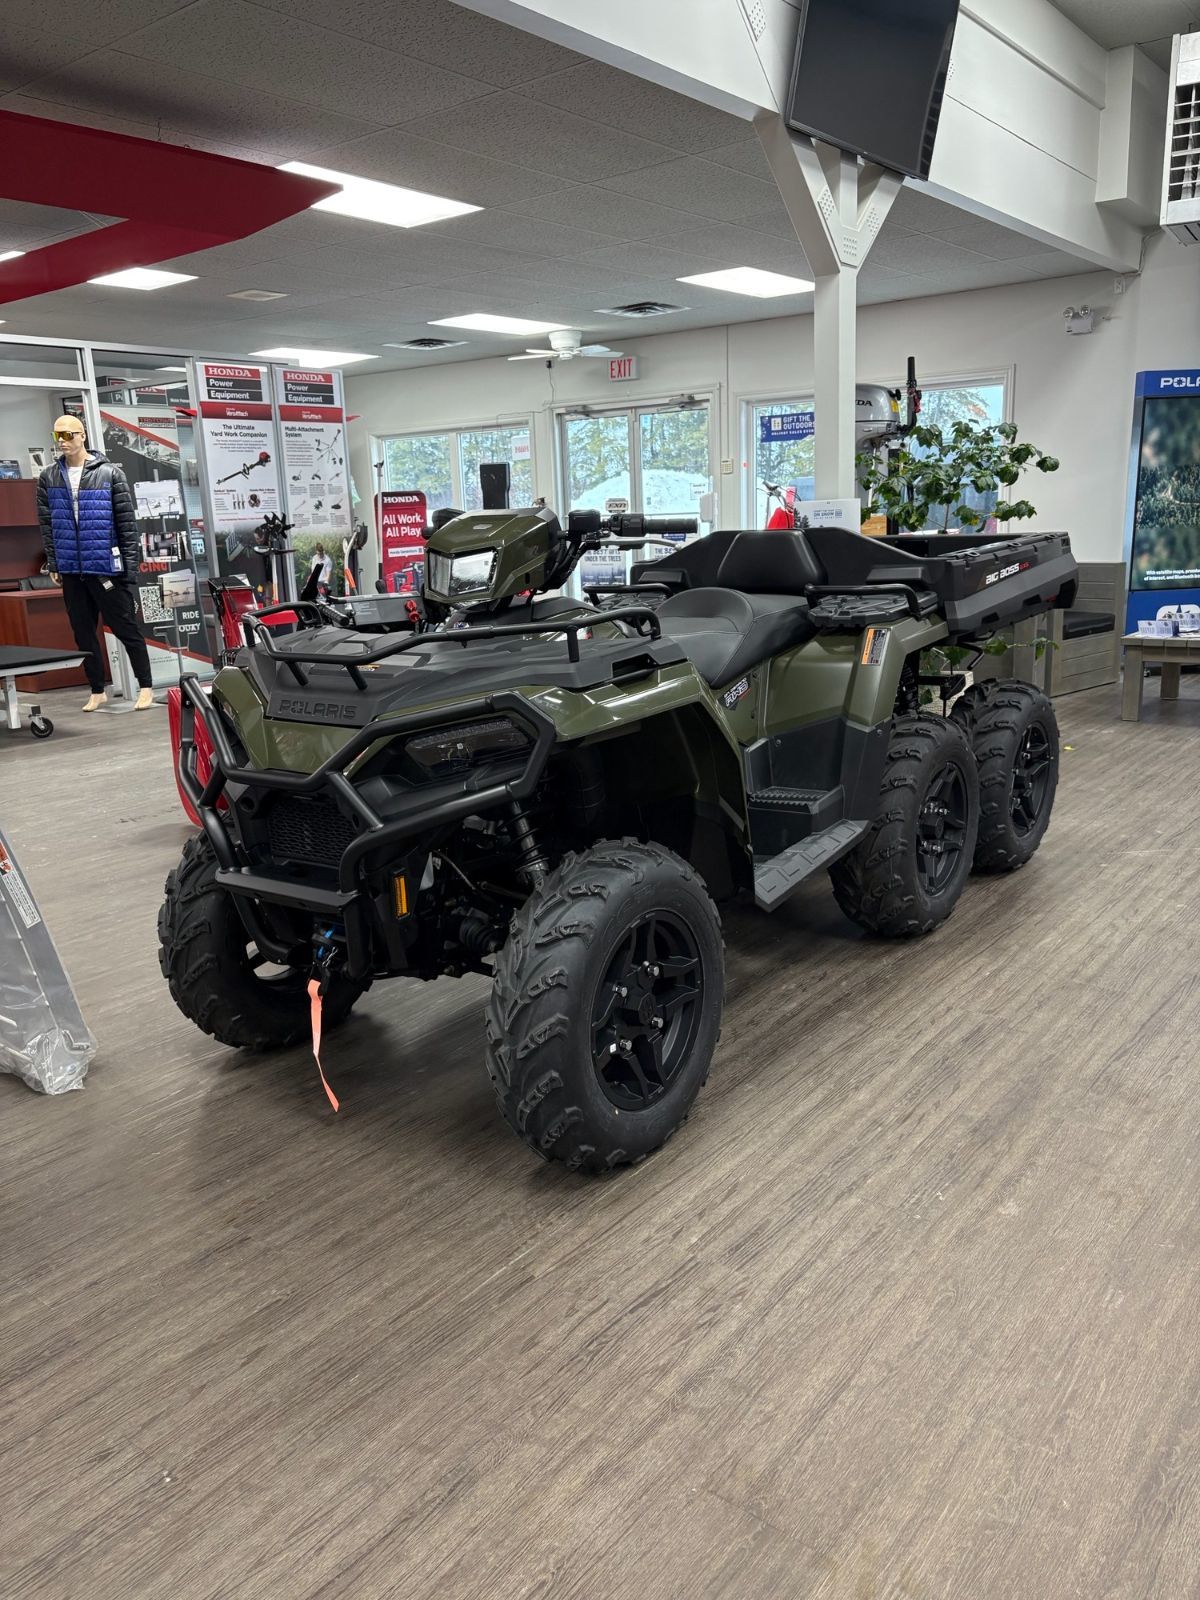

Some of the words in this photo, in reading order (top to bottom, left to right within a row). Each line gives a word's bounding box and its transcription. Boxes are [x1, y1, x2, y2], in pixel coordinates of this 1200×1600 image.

[207, 366, 252, 377] HONDA
[610, 359, 632, 379] EXIT
[286, 372, 325, 382] HONDA
[209, 379, 234, 388] Power
[287, 384, 309, 392] Power
[210, 390, 250, 400] Equipment
[288, 395, 323, 403] Equipment
[783, 416, 797, 424] GIFT
[799, 414, 811, 422] THE
[239, 431, 268, 439] Companion
[383, 495, 420, 504] HONDA
[383, 514, 397, 525] All
[398, 512, 424, 524] Work.
[386, 527, 400, 538] All
[985, 571, 999, 585] BIG
[1000, 562, 1020, 579] BOSS
[182, 610, 200, 619] RIDE
[279, 699, 358, 719] POLARIS
